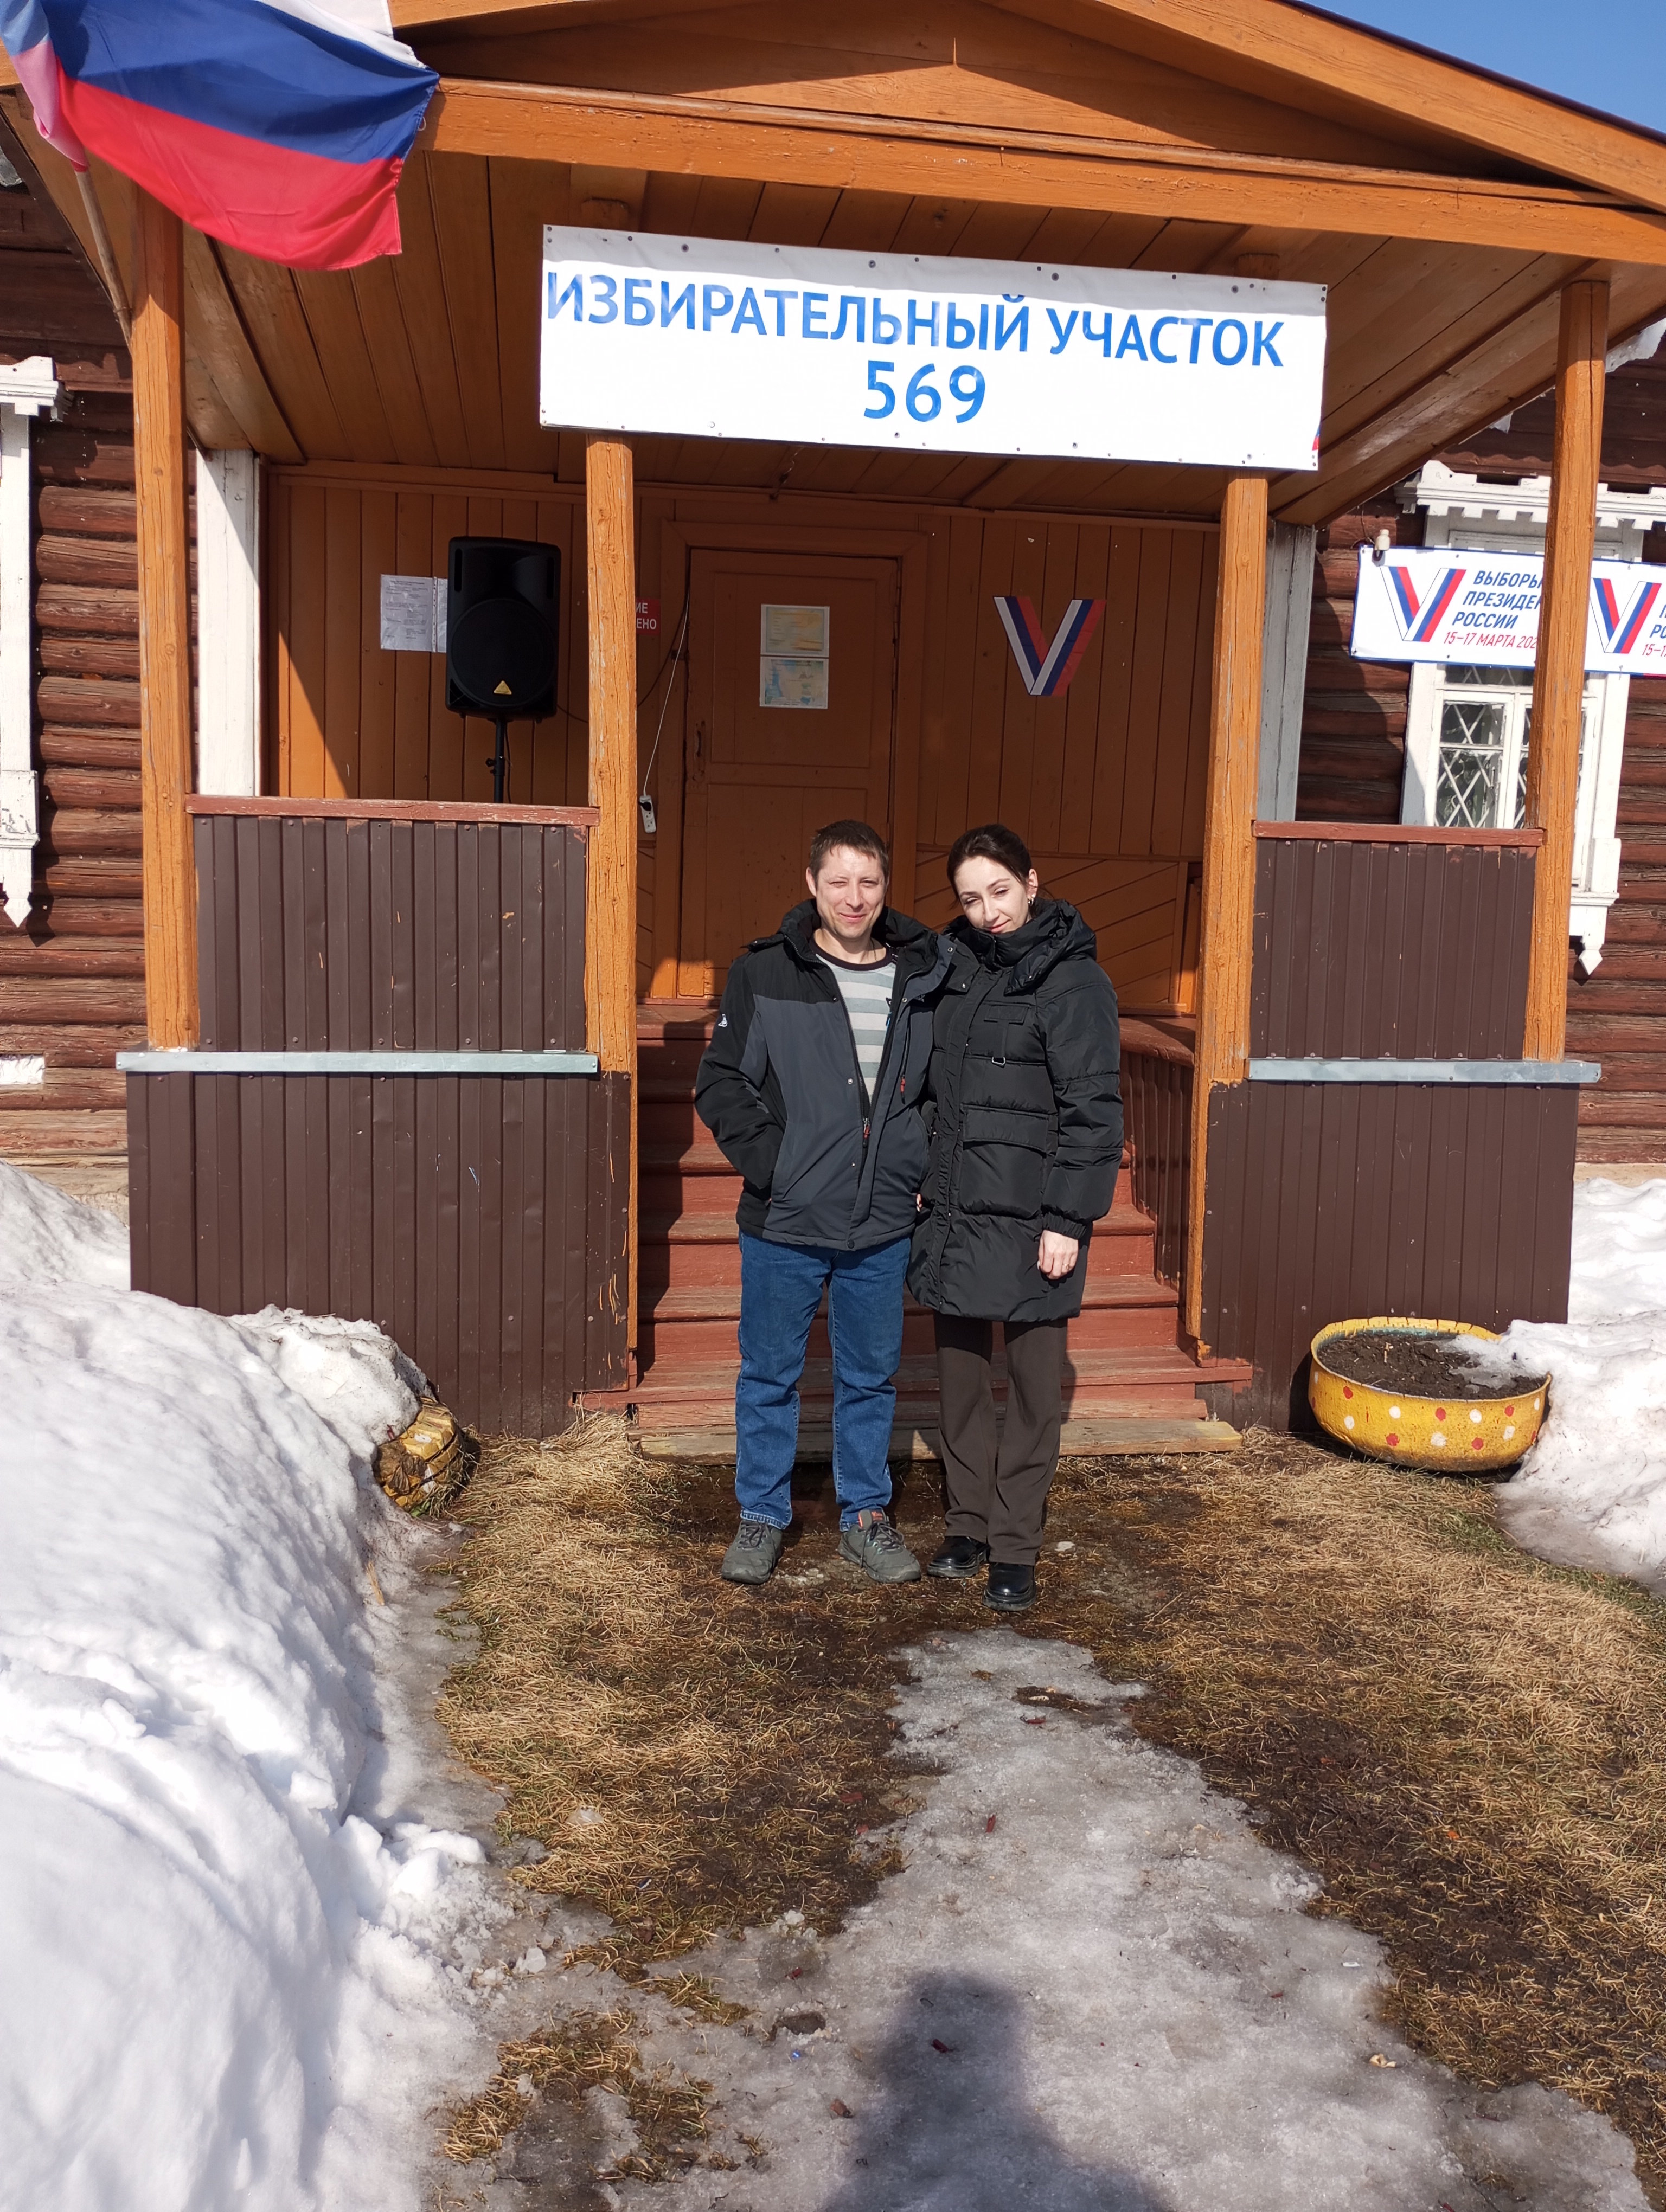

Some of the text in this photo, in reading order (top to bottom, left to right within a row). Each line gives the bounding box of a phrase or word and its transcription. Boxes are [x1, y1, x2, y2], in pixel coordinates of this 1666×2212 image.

[546, 272, 1285, 368] ИЗБИРАТЕЛЬНЫЙ УЧАСТОК
[863, 361, 987, 424] 569
[1452, 612, 1518, 629] РОССИИ
[1476, 633, 1516, 647] МАРТА
[1642, 644, 1666, 657] 15–1
